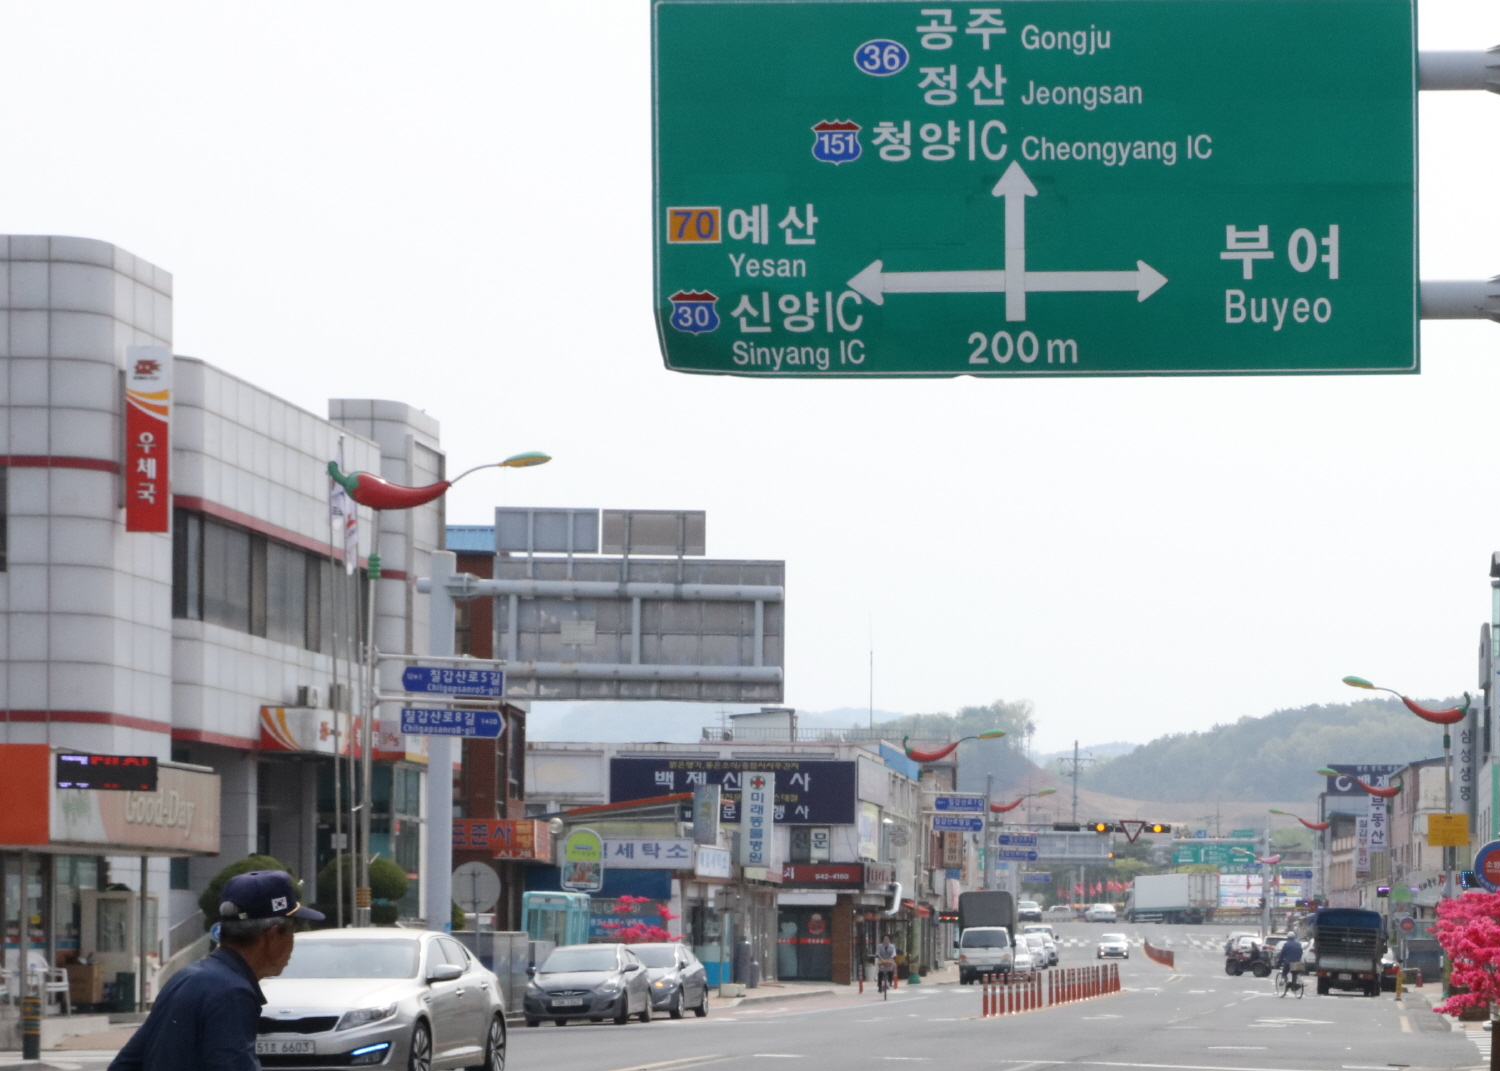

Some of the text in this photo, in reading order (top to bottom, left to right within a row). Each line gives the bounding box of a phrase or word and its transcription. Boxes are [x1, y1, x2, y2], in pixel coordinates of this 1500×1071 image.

[916, 7, 1007, 52] 공주
[1021, 25, 1111, 52] Gongju
[863, 45, 900, 71] 36
[917, 66, 1007, 106] 정산
[1021, 81, 1143, 107] Jeongsan
[820, 133, 855, 155] 151
[871, 119, 1008, 162] 청양IC
[1021, 135, 1213, 164] Cheongyang IC
[674, 211, 714, 239] 70
[727, 203, 818, 246] 예산
[729, 253, 807, 279] Yesan
[1220, 224, 1339, 281] 부여
[679, 304, 710, 328] 30
[731, 290, 864, 333] 신양IC
[1225, 290, 1332, 331] Buyeo
[732, 340, 865, 370] Sinyang IC
[136, 431, 157, 505] 우체국
[1460, 729, 1472, 801] 삼성생명
[655, 770, 812, 792] 백제신사
[749, 792, 765, 863] 미래동물병원
[281, 1042, 309, 1053] 6603
